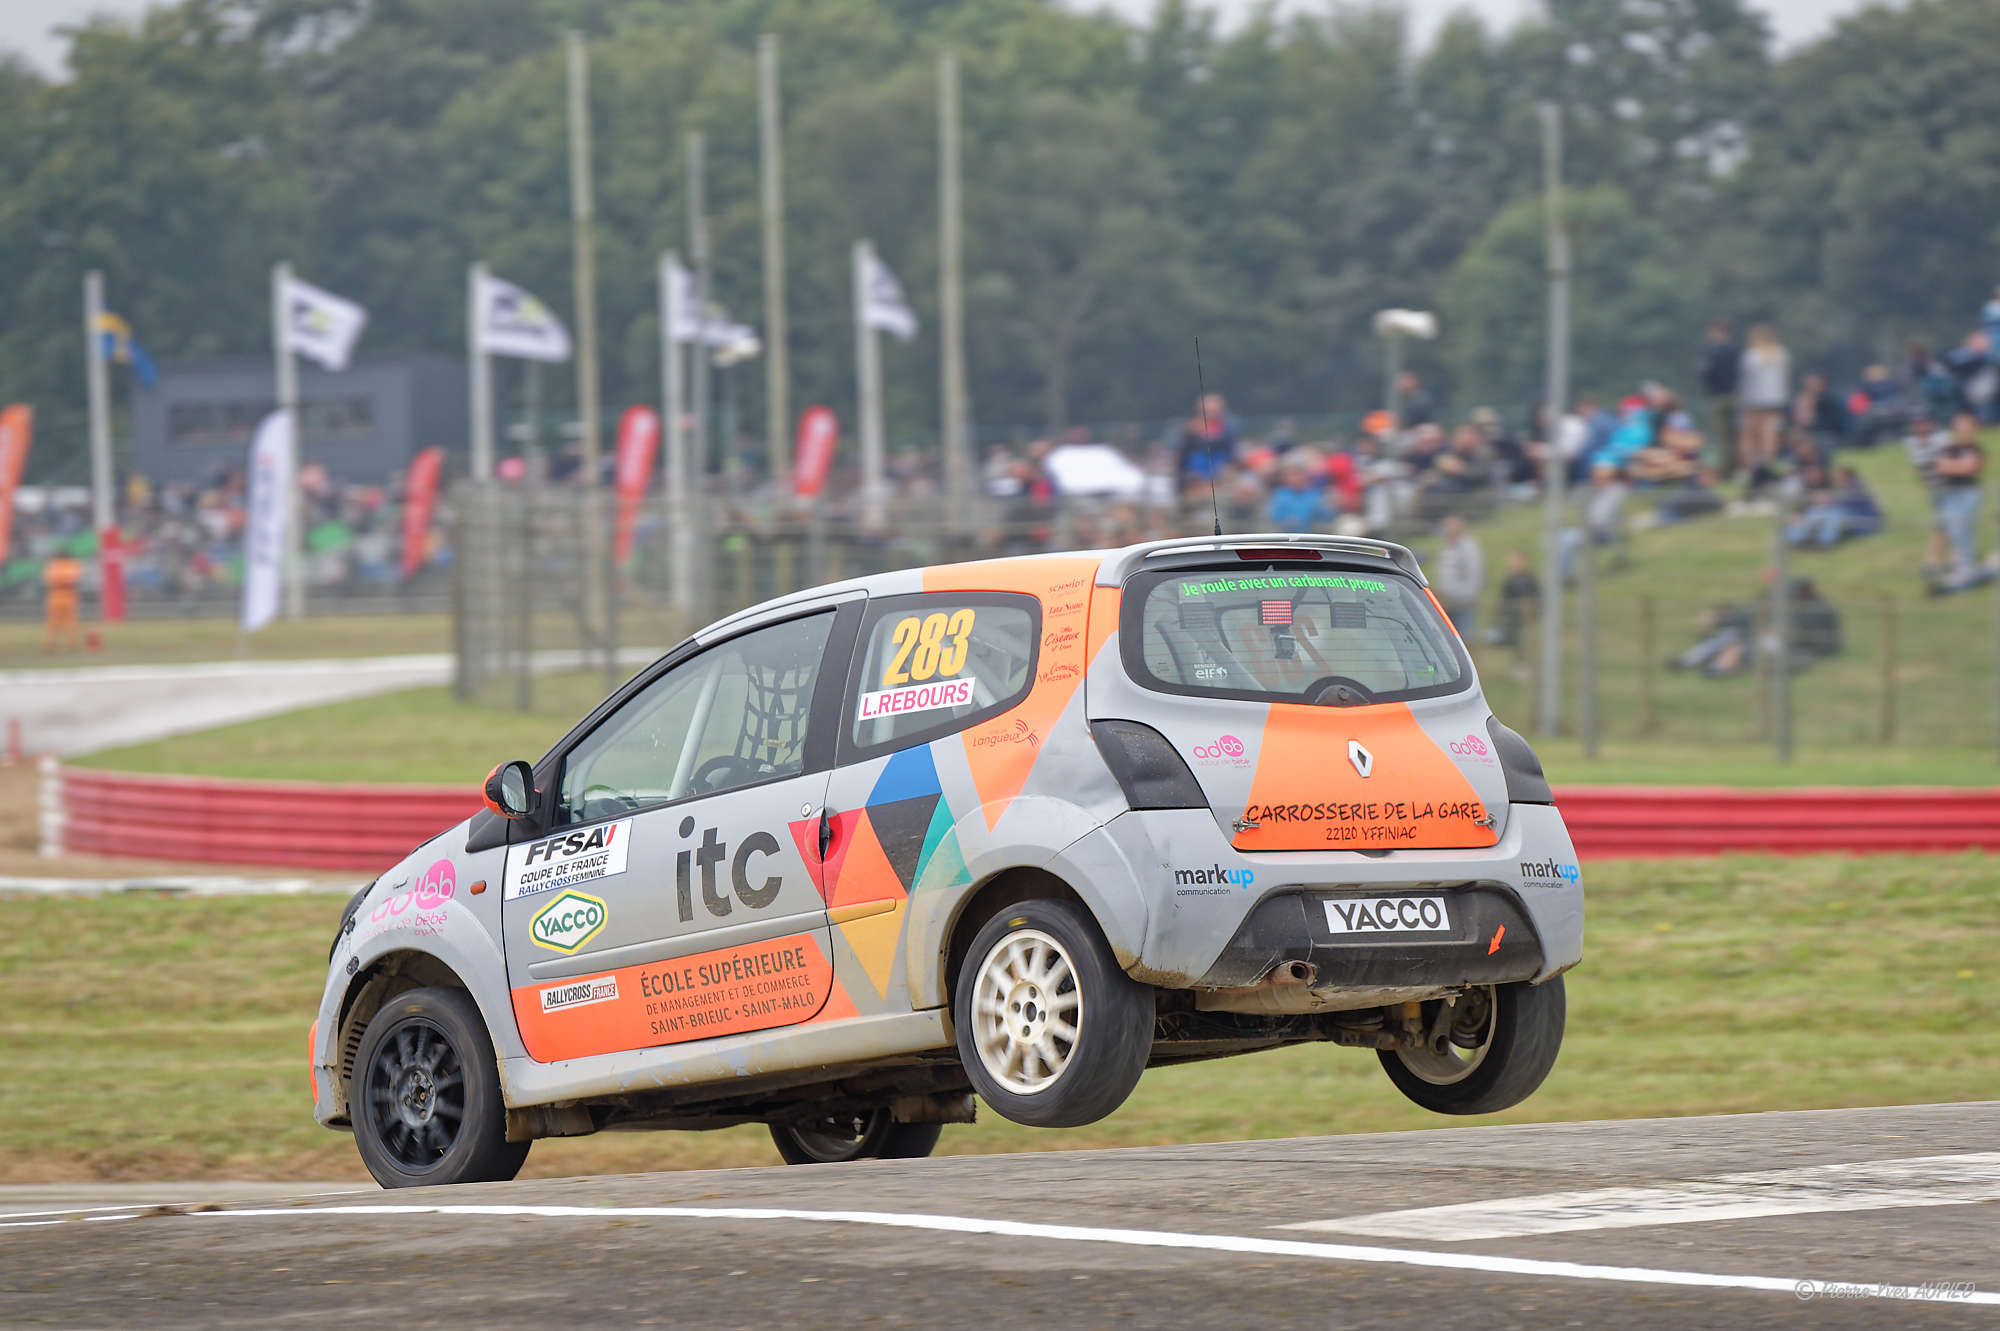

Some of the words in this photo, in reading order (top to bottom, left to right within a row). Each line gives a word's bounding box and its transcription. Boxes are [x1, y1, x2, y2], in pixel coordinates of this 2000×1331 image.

[1182, 582, 1199, 597] Je
[1200, 578, 1237, 595] roule
[1238, 578, 1269, 591] avec
[1270, 576, 1288, 588] un
[1289, 574, 1349, 588] carburant
[1348, 578, 1387, 594] propre
[882, 608, 976, 686] 283
[863, 682, 969, 716] L.REBOURS
[1246, 802, 1380, 823] CARROSSERIE
[1384, 802, 1407, 820] DE
[1412, 801, 1434, 819] LA
[1438, 802, 1482, 821] GARE
[525, 827, 604, 866] FFSA
[1326, 826, 1358, 841] 22120
[1362, 826, 1418, 840] YFFINIAC
[520, 867, 553, 885] COUPE
[555, 863, 570, 876] DE
[570, 854, 610, 873] FRANCE
[677, 816, 782, 923] itc
[1174, 863, 1255, 889] markup
[1520, 857, 1579, 885] markup
[518, 875, 571, 896] RALLYCROSS
[1176, 887, 1231, 897] communication
[539, 906, 598, 937] YACCO
[1332, 898, 1442, 930] YACCO
[640, 967, 695, 998] ÉCOLE
[698, 947, 807, 987] SUPÉRIEURE
[546, 984, 592, 1007] RALLYCROSS
[592, 983, 617, 1000] FRANCE
[646, 1003, 659, 1016] DE
[660, 991, 726, 1015] MANAGEMENT
[727, 988, 740, 1001] ET
[743, 986, 756, 998] DE
[757, 974, 811, 995] COMMERCE
[650, 1007, 732, 1035] SAINT-BRIEUC
[743, 991, 816, 1018] SAINT-MALO
